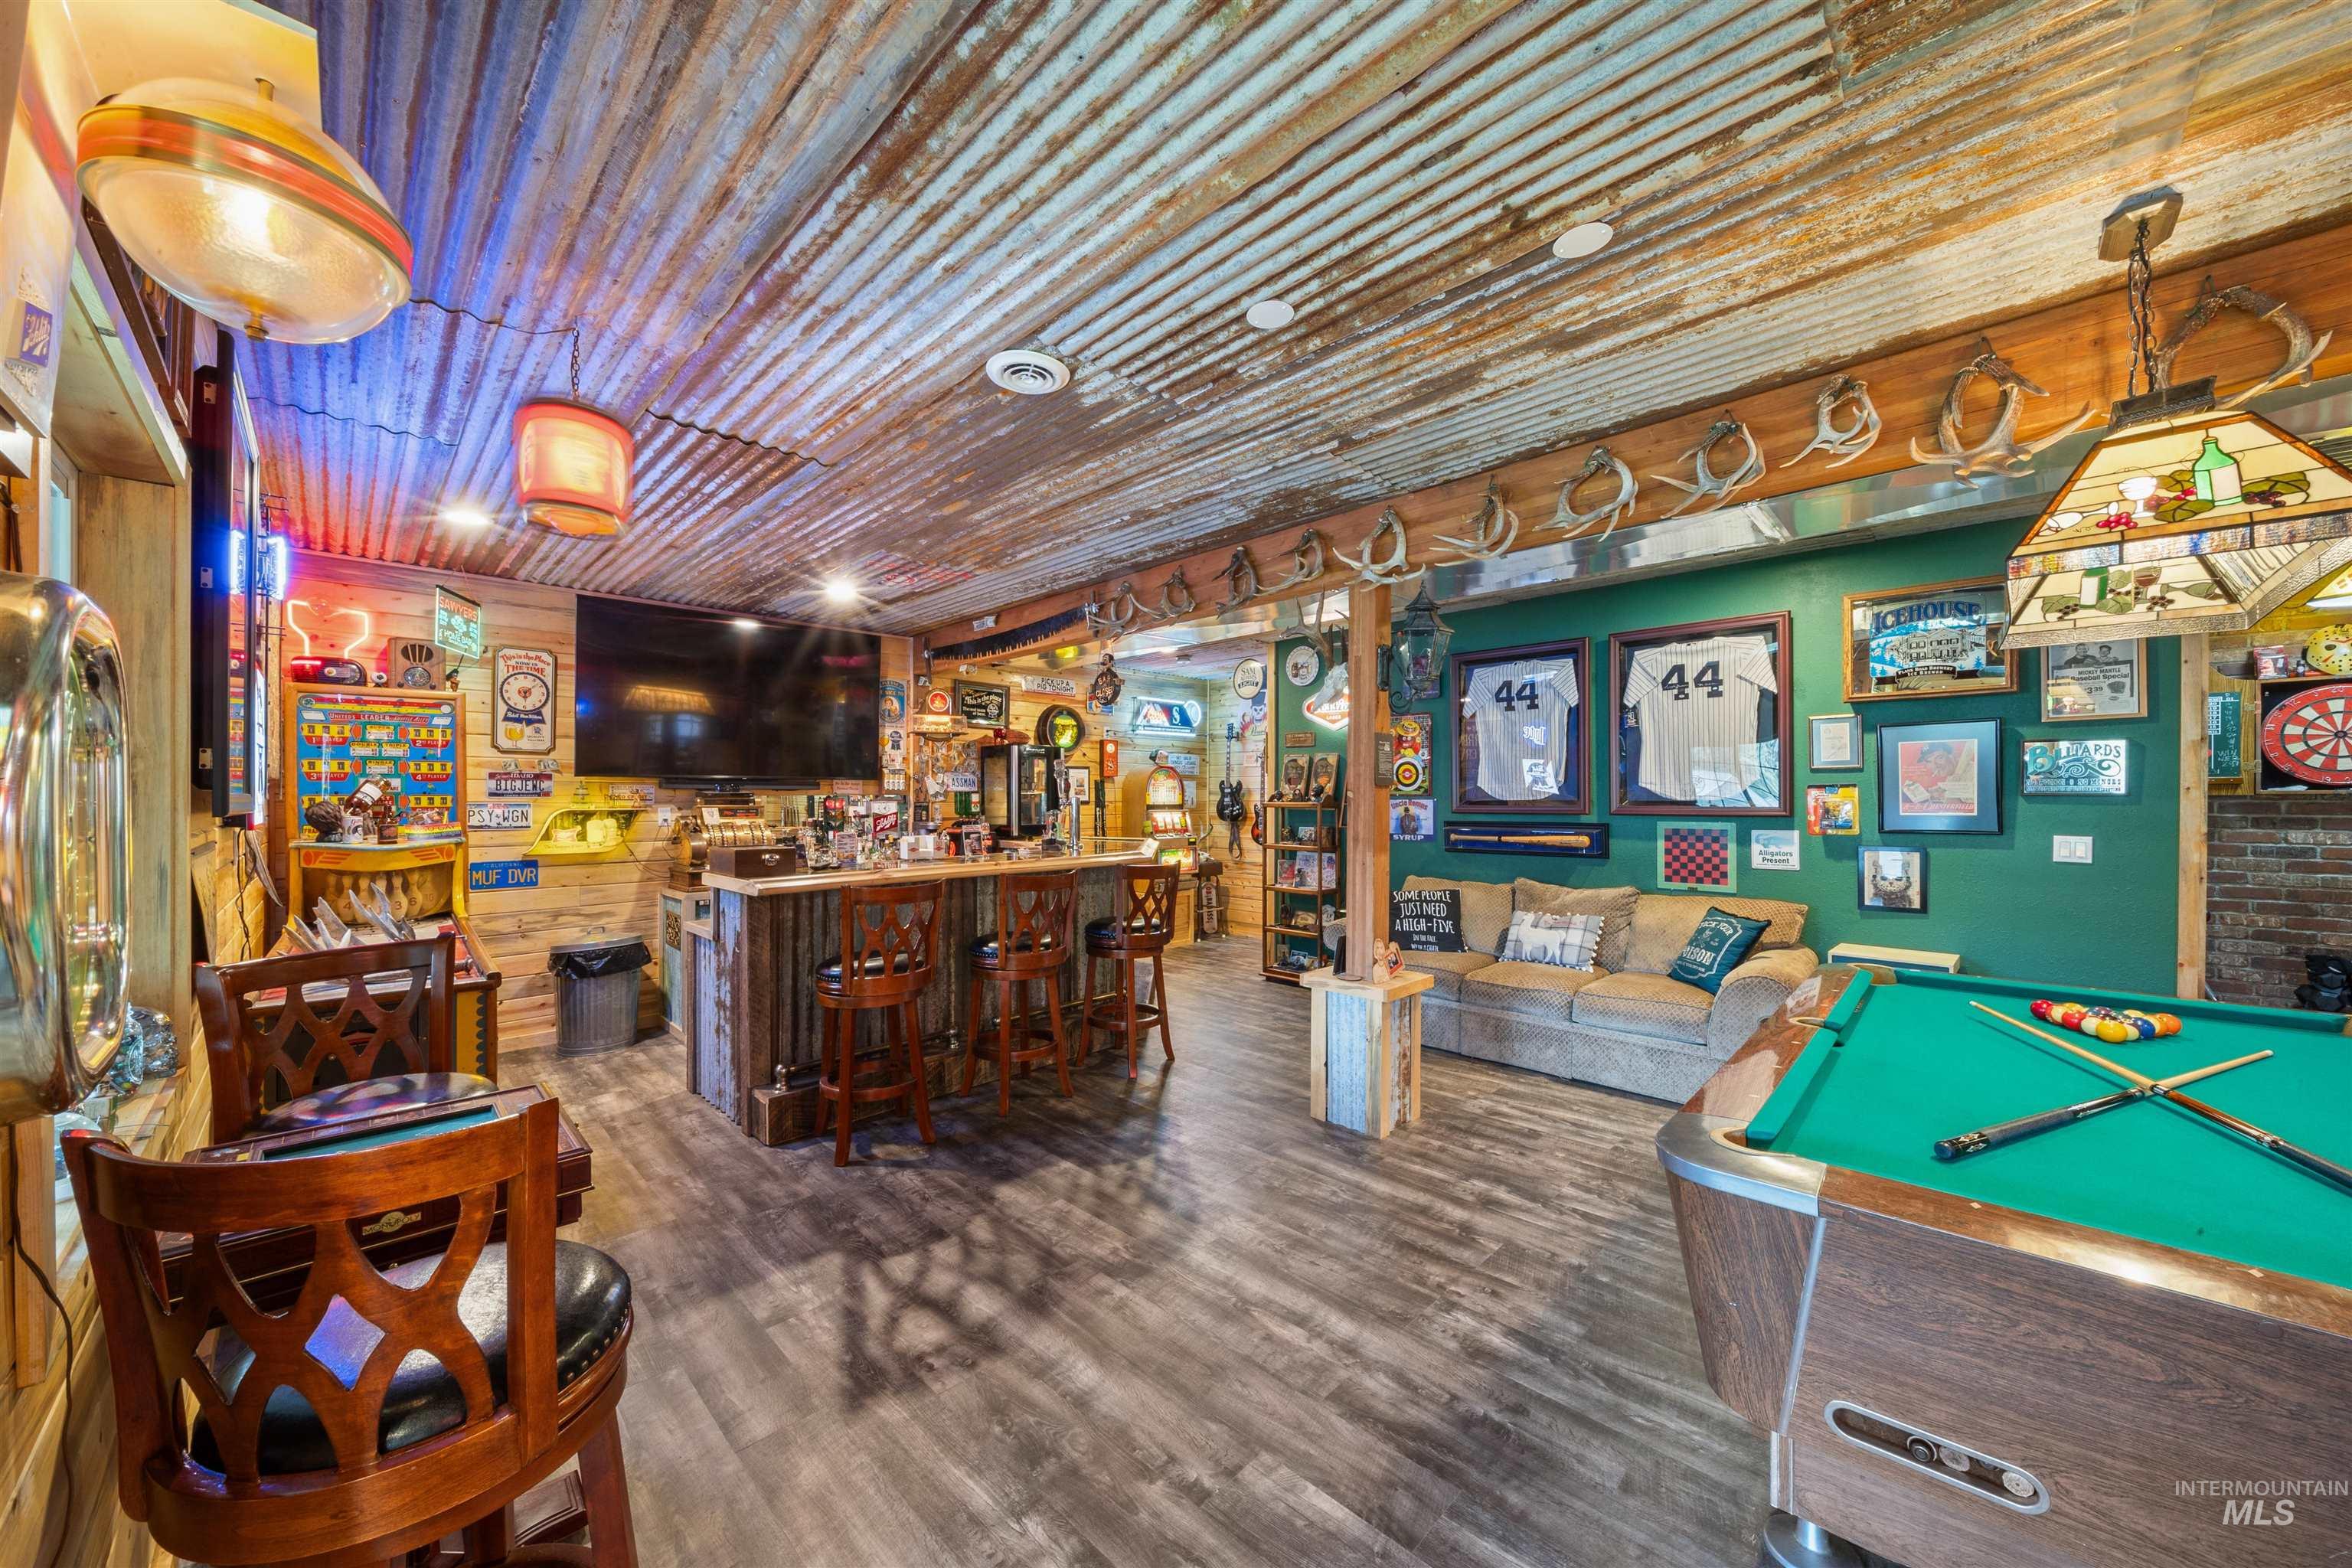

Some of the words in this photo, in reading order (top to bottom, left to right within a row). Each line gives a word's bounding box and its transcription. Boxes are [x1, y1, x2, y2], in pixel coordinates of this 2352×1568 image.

[439, 596, 478, 622] SAWYERS
[1873, 600, 1981, 635] ICEHOUSE
[500, 653, 516, 664] This
[523, 652, 534, 661] the
[534, 655, 551, 667] Place
[504, 664, 523, 674] THE
[523, 665, 546, 677] TIME
[1240, 667, 1256, 676] SAM
[1041, 677, 1056, 685] PICK
[1096, 675, 1112, 685] BAR
[1661, 660, 1723, 701] 44
[1047, 684, 1074, 693] TONIGHT
[965, 695, 977, 705] This
[989, 694, 1002, 703] place
[1494, 679, 1539, 712] 44
[361, 714, 390, 722] LEADER
[495, 779, 545, 792] BIGJEWC
[952, 776, 976, 788] ASSMAN
[1391, 799, 1408, 809] Uncle
[1408, 799, 1429, 811] Remus
[468, 809, 494, 823] PSY
[502, 809, 528, 822] WGN
[875, 814, 897, 831] Schlitz
[1393, 833, 1425, 841] SYRUP
[1759, 849, 1794, 858] Alligators
[472, 869, 502, 886] MUF
[508, 868, 537, 884] DVR
[410, 893, 417, 906] 6
[1393, 890, 1419, 903] SOME
[1421, 890, 1452, 903] PEOPLE
[394, 900, 402, 911] 3
[1400, 902, 1422, 918] JUST
[1423, 902, 1447, 917] NEED
[1395, 920, 1402, 932] A
[1717, 922, 1734, 936] YOUR
[1413, 933, 1419, 942] IN
